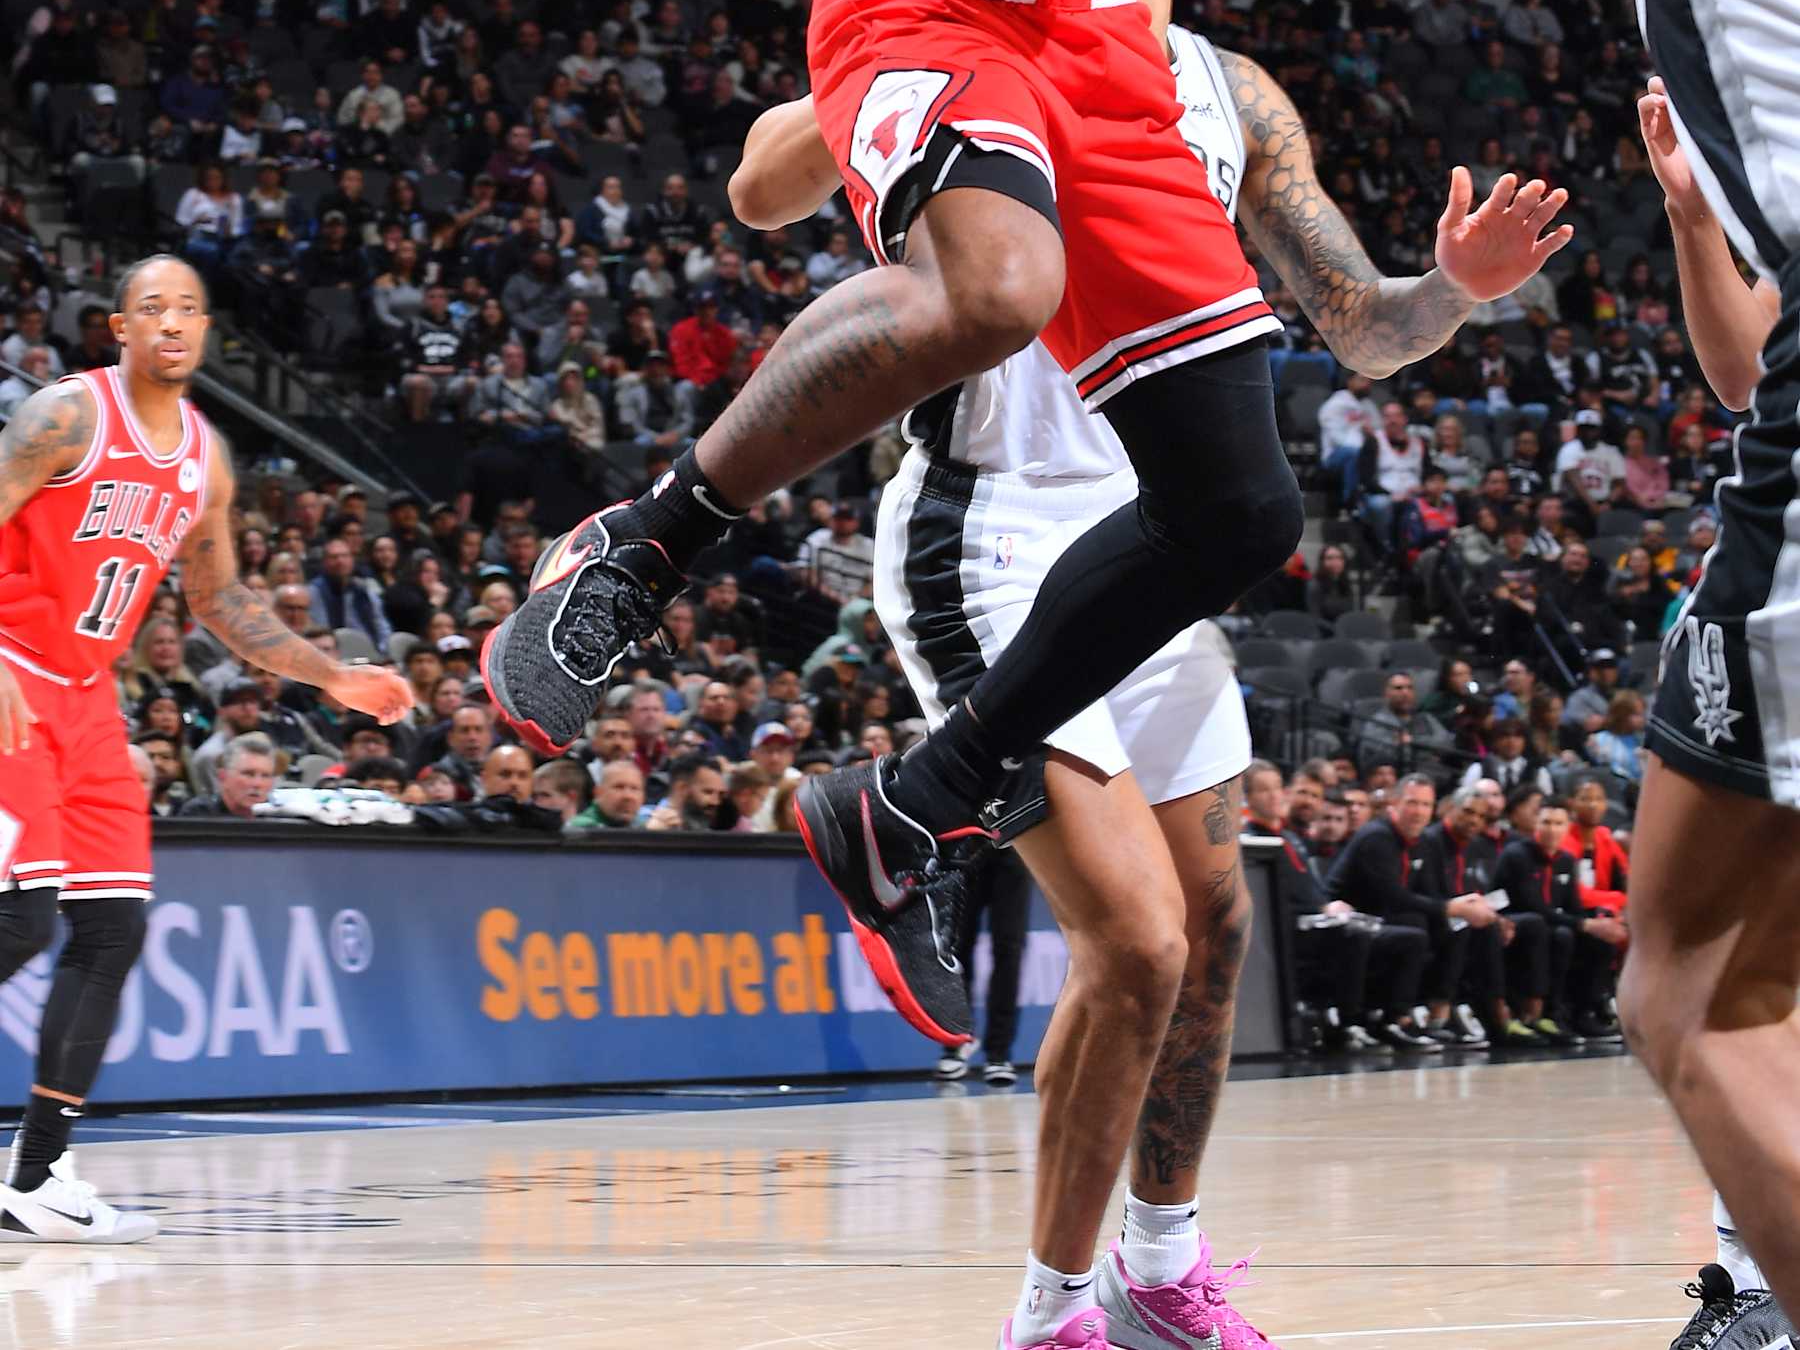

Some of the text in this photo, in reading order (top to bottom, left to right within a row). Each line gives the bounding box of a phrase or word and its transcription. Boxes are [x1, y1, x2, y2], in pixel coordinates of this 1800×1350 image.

[75, 556, 147, 640] 11
[476, 907, 600, 1022] See
[606, 931, 766, 1017] more
[772, 913, 835, 1013] at
